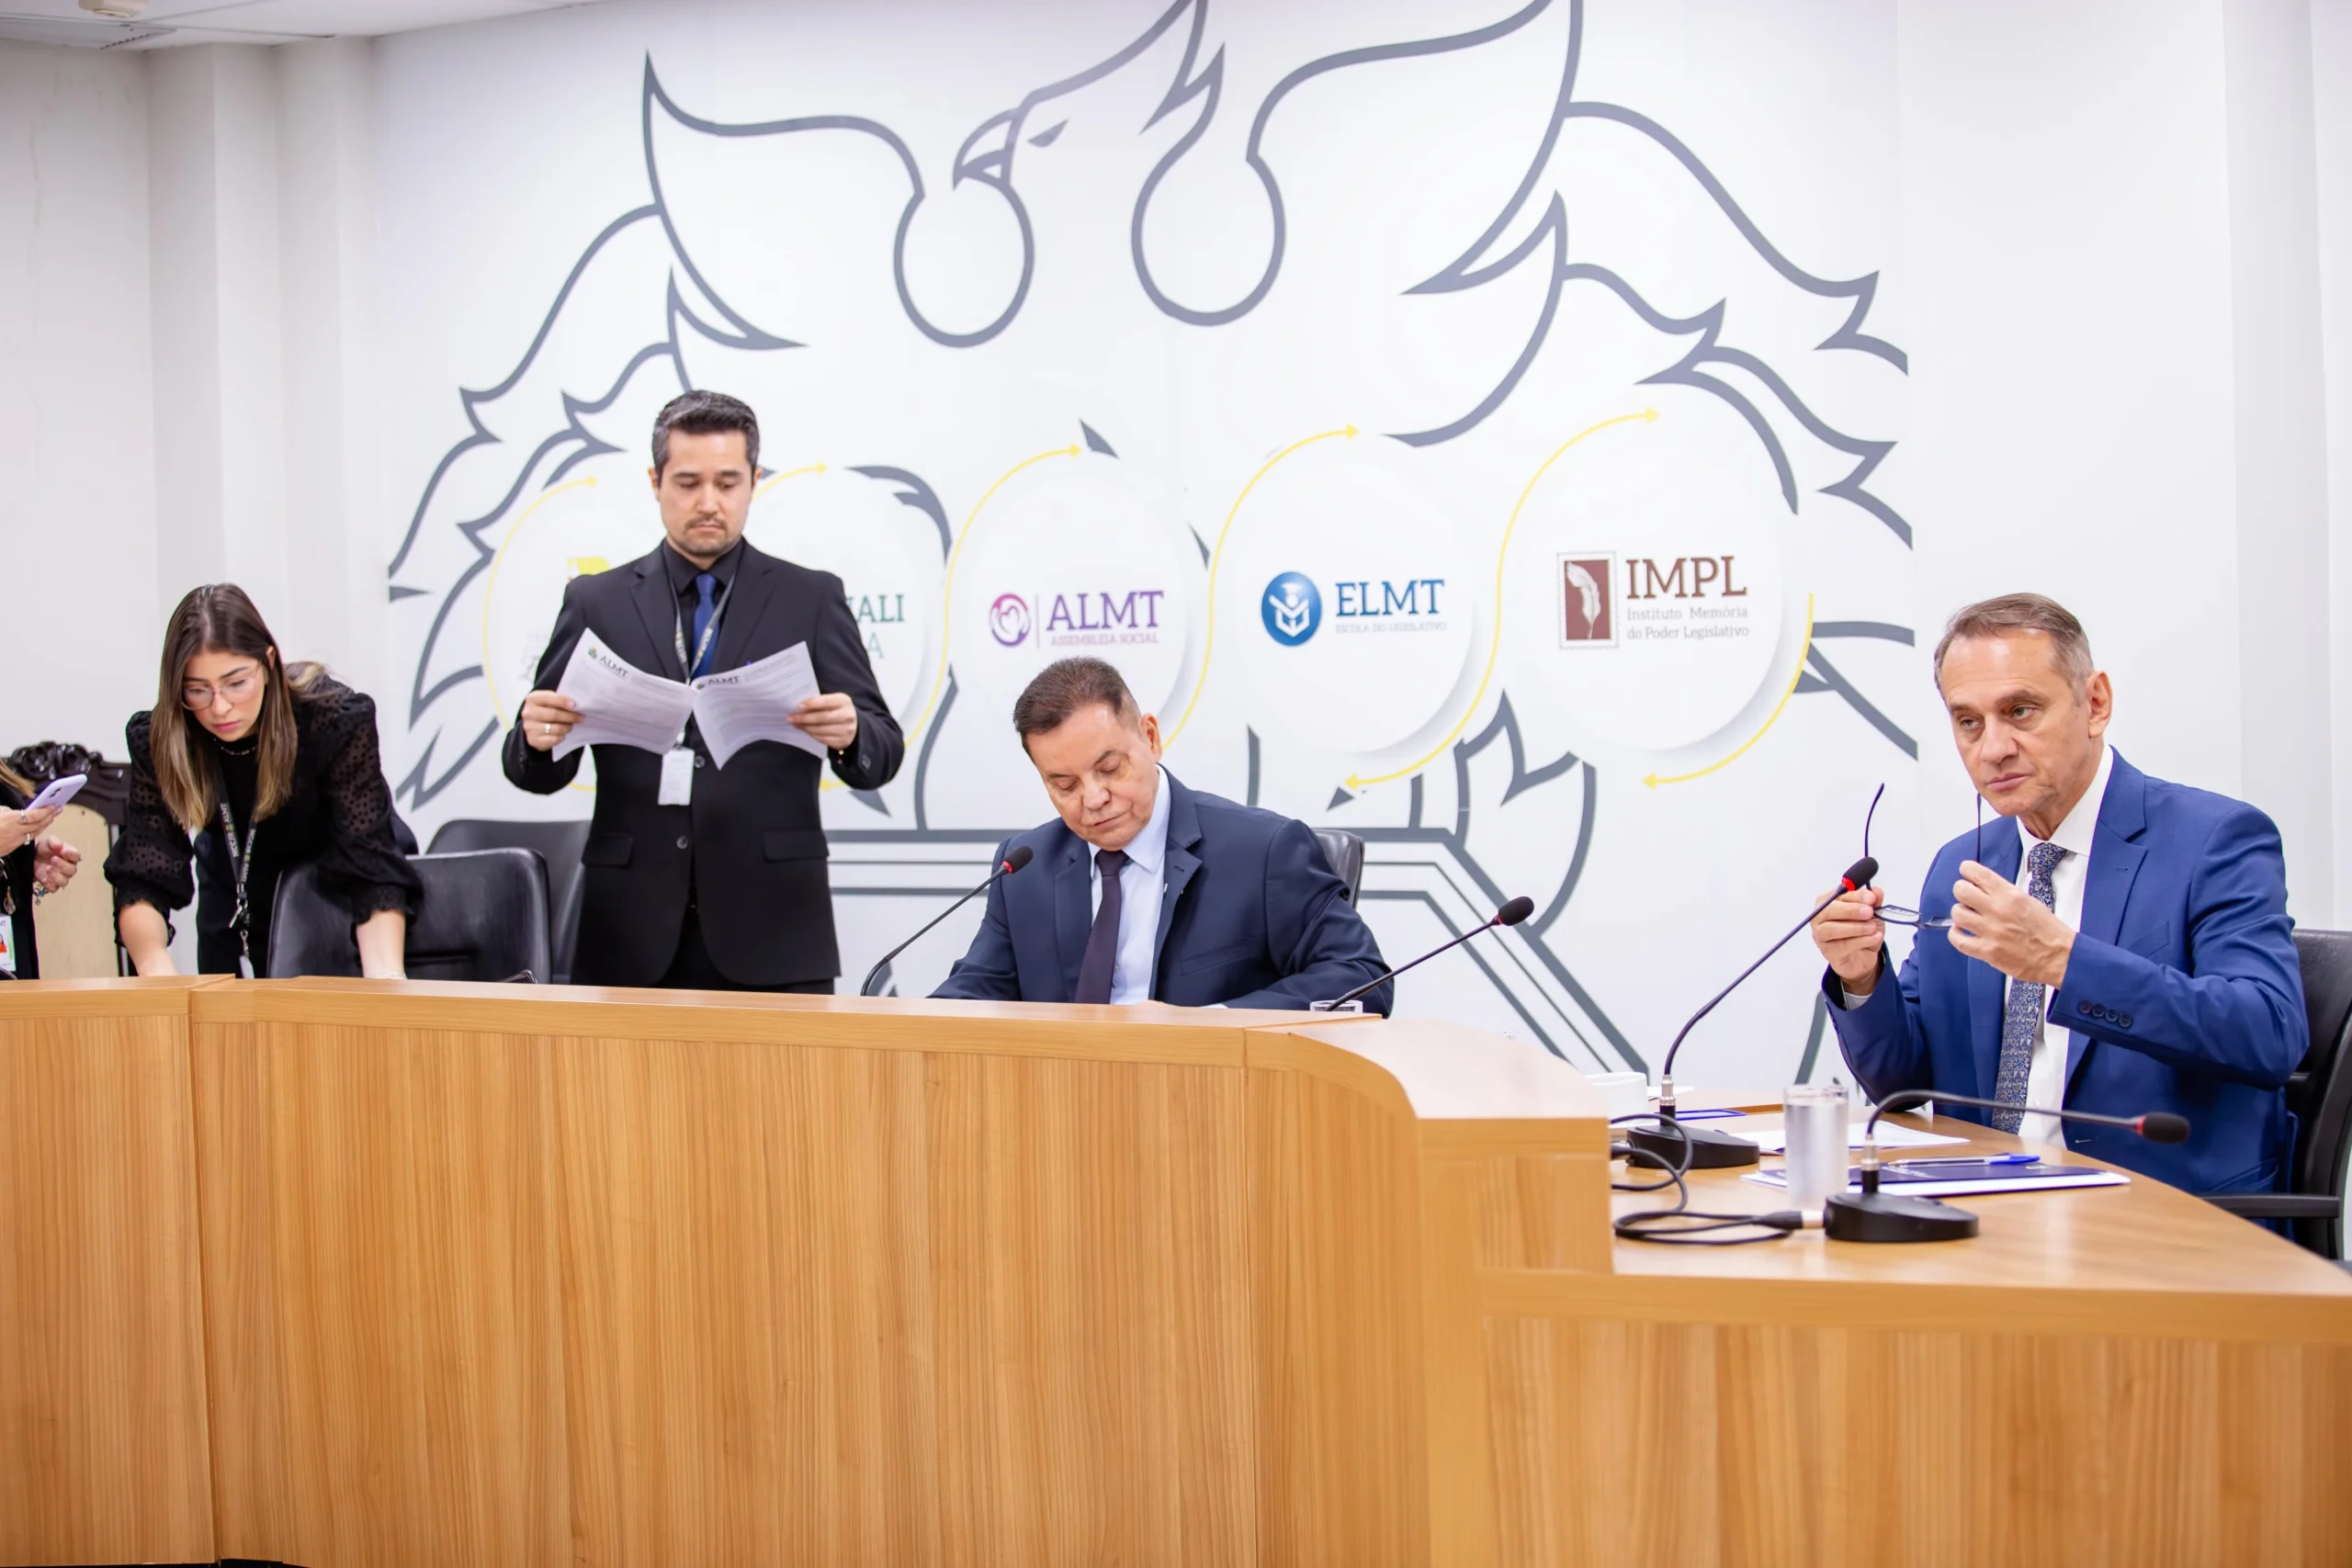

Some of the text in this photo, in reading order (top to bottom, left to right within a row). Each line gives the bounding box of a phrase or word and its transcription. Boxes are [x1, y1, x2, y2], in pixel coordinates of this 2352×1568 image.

[1625, 555, 1747, 599] IMPL
[846, 593, 905, 623] ALI
[1046, 591, 1164, 631] ALMT
[1335, 579, 1445, 617] ELMT
[1627, 605, 1748, 621] Instituto Memória
[1627, 624, 1749, 640] do Poder Legislativo
[599, 654, 629, 678] ALMT
[707, 675, 741, 685] ALMT
